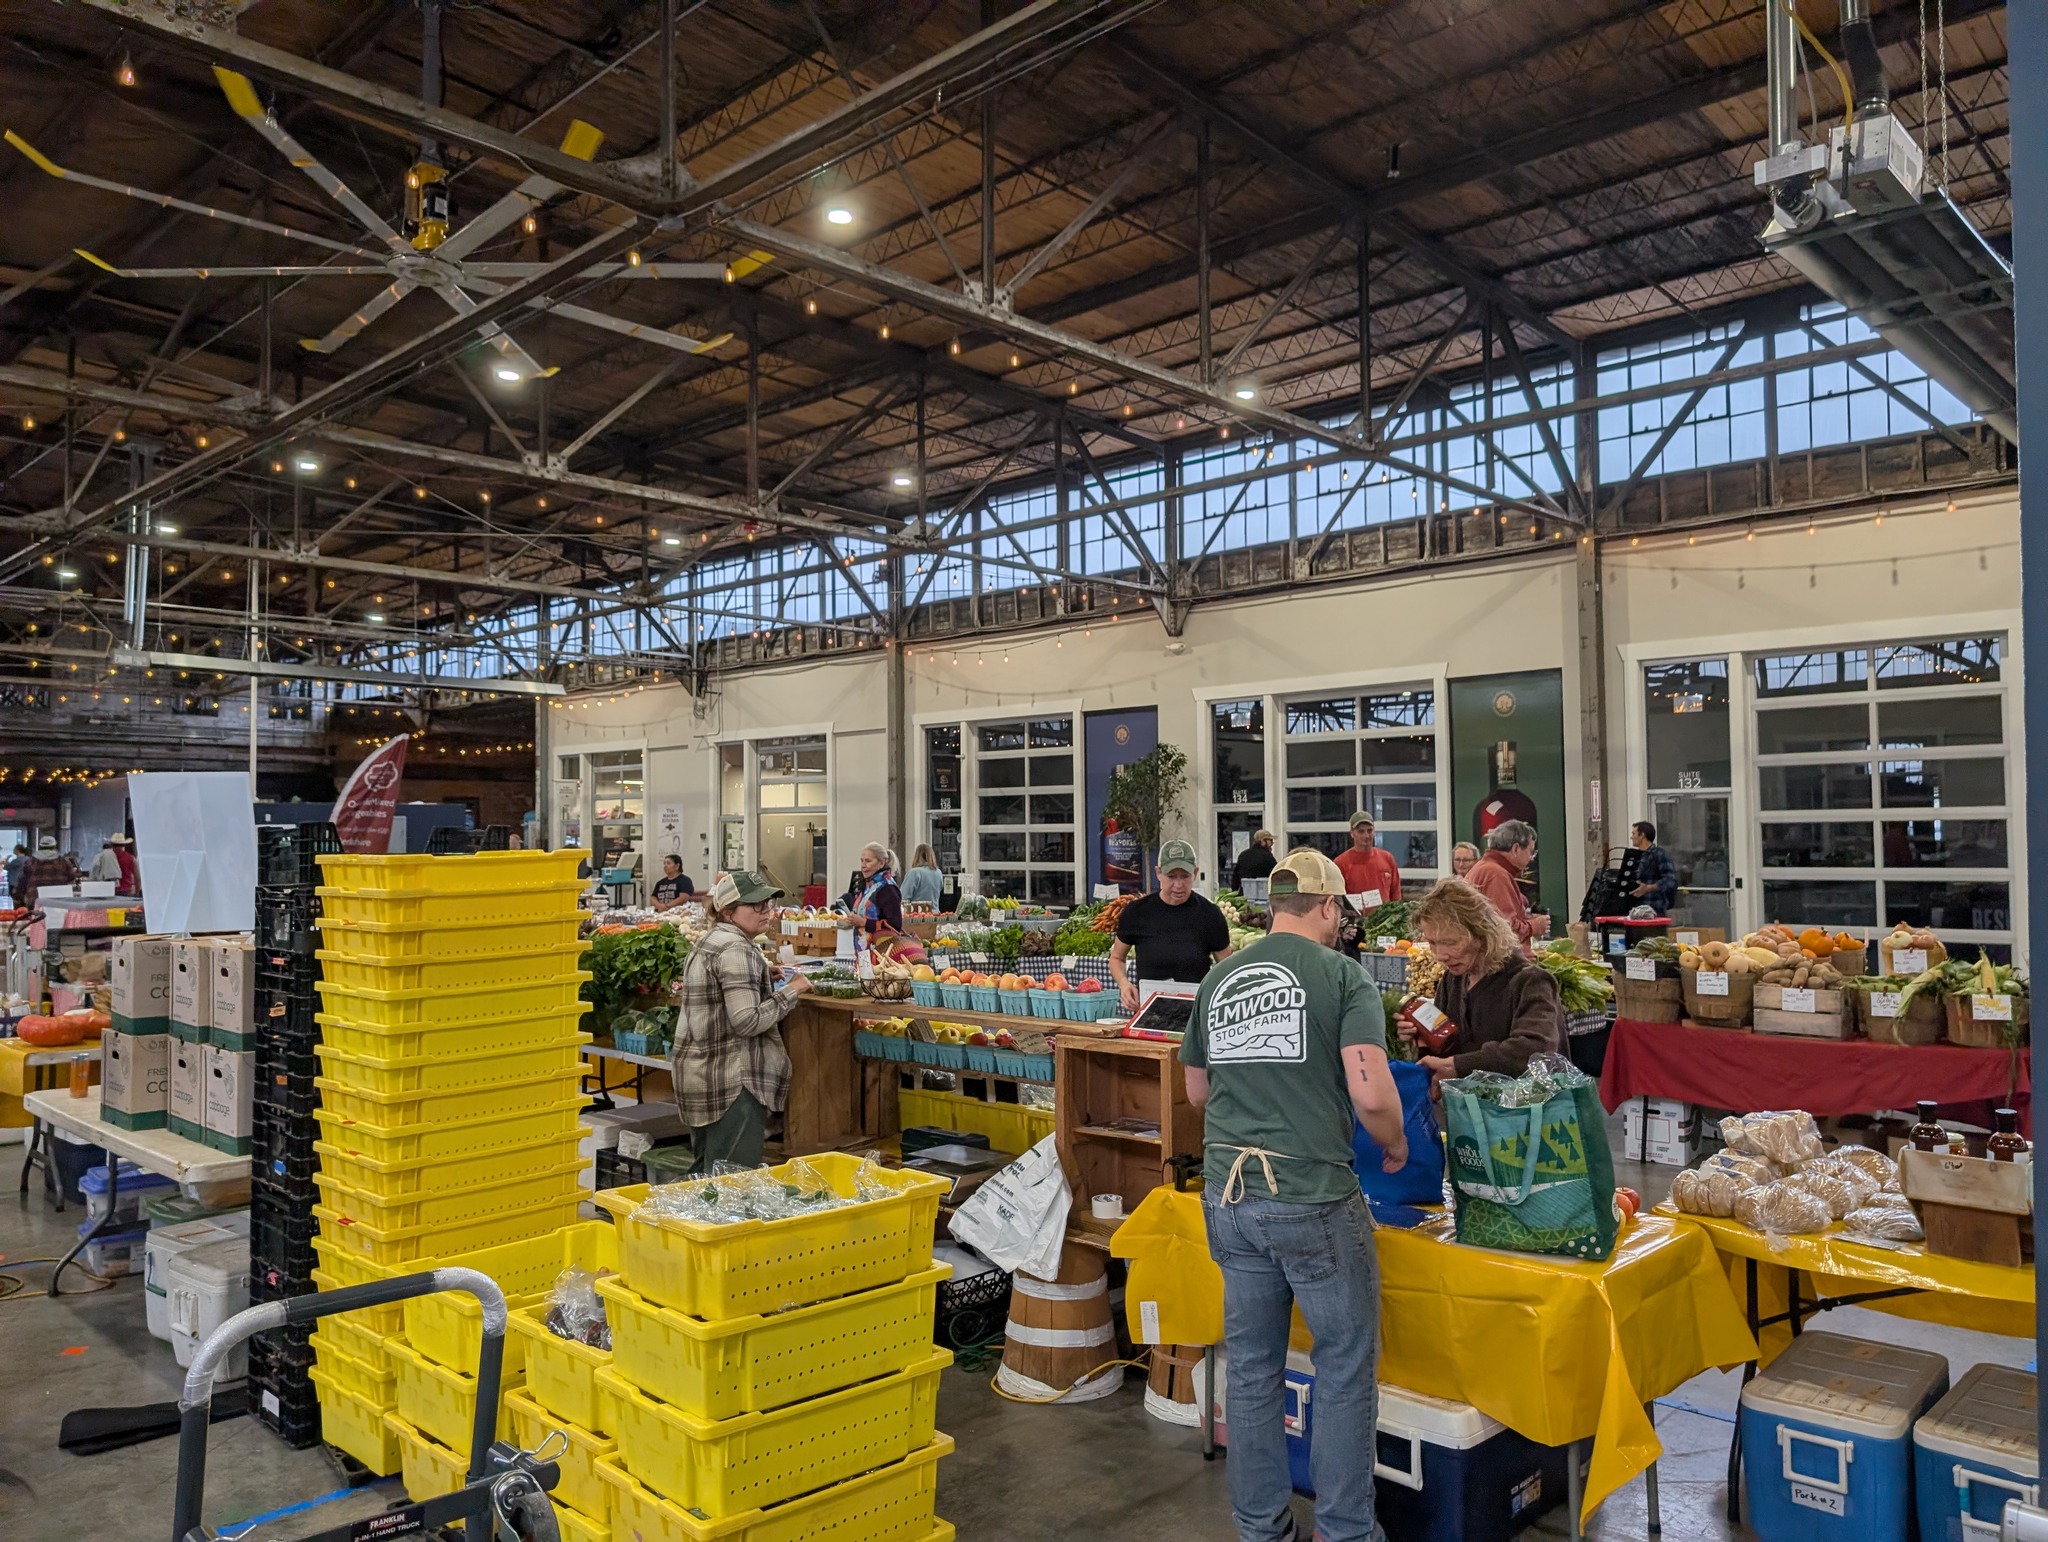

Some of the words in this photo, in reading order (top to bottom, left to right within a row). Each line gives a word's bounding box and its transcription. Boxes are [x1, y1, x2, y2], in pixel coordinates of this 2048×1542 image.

[1678, 778, 1701, 789] 132
[1232, 794, 1248, 803] 134
[1208, 987, 1306, 1032] ELMWOOD
[1215, 1022, 1251, 1042] STOCK
[1254, 1013, 1291, 1029] FARM
[1795, 1489, 1818, 1502] Pork
[1828, 1499, 1837, 1510] 2
[370, 1513, 405, 1530] FRANKLIN
[376, 1527, 396, 1537] HAND
[397, 1520, 420, 1532] TRUCK
